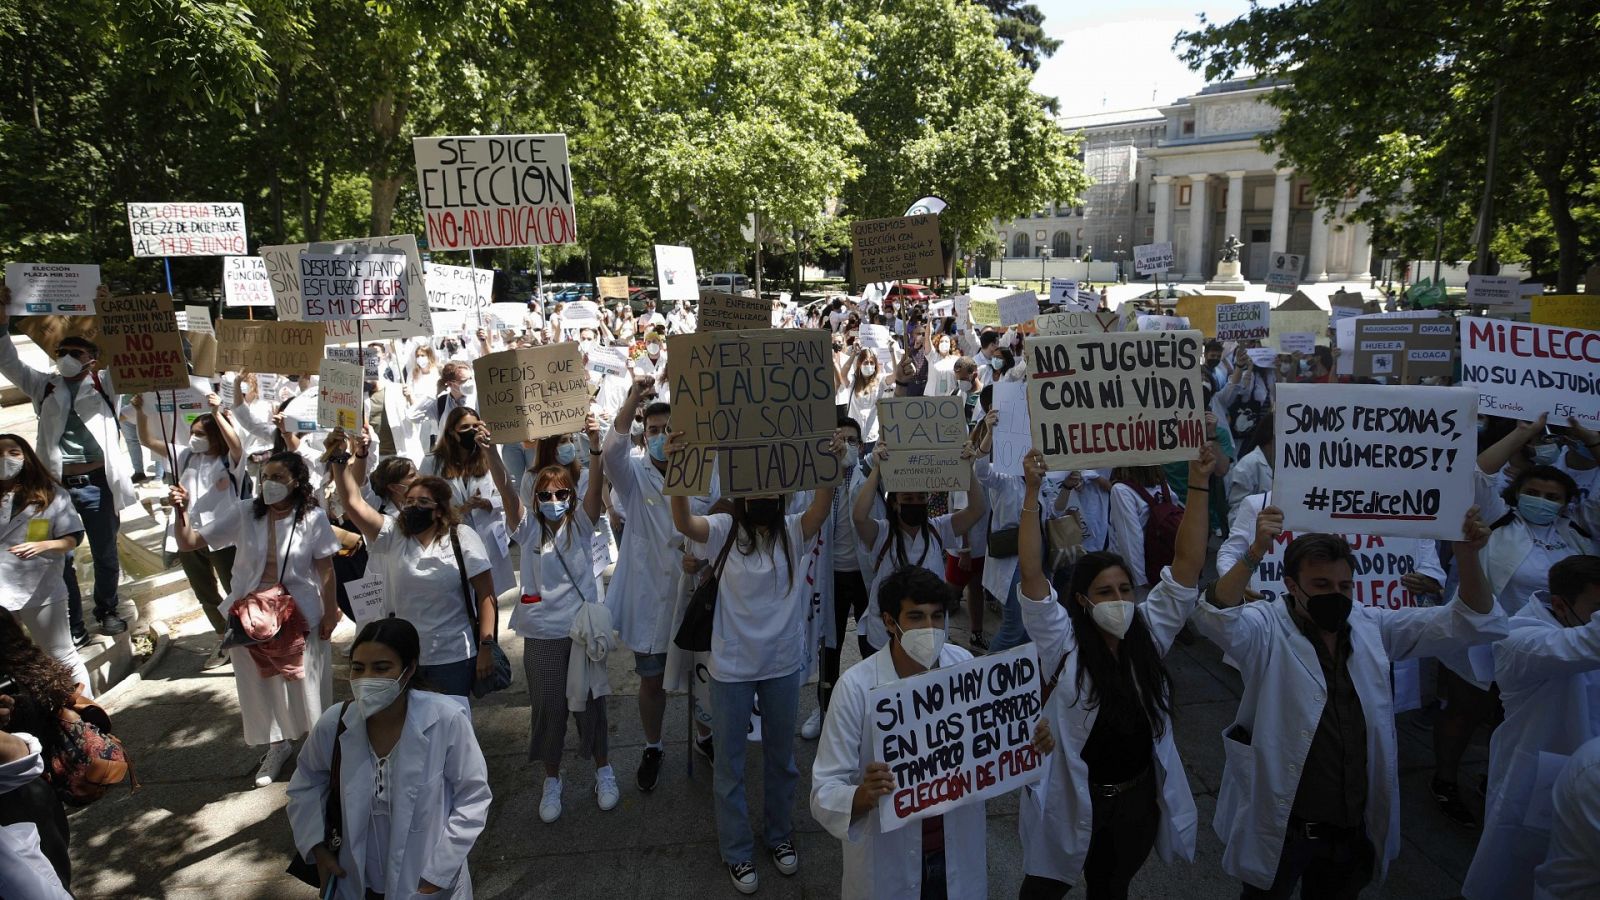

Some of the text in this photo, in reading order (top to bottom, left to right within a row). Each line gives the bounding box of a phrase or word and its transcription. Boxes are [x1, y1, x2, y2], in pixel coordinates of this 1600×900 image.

[438, 139, 547, 165] SE DICE
[131, 205, 242, 219] LA LOTERIA PASA
[133, 221, 240, 236] DEL 22 DE DICIEMBRE
[855, 216, 929, 235] QUEREMOS UNA
[136, 240, 155, 255] AL
[179, 237, 196, 254] DE
[200, 235, 245, 254] JUNIO
[898, 232, 913, 241] CON
[928, 239, 934, 247] Y
[232, 259, 265, 269] SI YA
[265, 251, 294, 272] SIN
[861, 258, 876, 266] QUE
[886, 256, 901, 264] LOS
[919, 249, 937, 258] NOS
[350, 259, 362, 277] DE
[364, 259, 404, 278] TANTO
[433, 266, 449, 277] SU
[880, 269, 919, 279] DECENCIA
[233, 282, 246, 292] PA
[272, 273, 300, 293] SIN
[303, 279, 405, 296] ESFUERZO ELEGIR
[101, 298, 159, 313] CAROLINA
[235, 293, 269, 302] TOCAS
[278, 296, 299, 315] NO
[428, 290, 449, 304] NOT
[704, 297, 717, 305] LA
[307, 299, 325, 316] ES
[351, 299, 408, 316] DERECHO
[123, 325, 135, 335] DE
[281, 328, 313, 346] OPACA
[1421, 325, 1451, 333] OPACA
[125, 334, 153, 351] NO
[1365, 342, 1393, 350] HUELE
[113, 350, 180, 367] ARRANCA
[254, 350, 261, 366] A
[267, 350, 309, 369] CLOACA
[328, 348, 354, 357] ERROR
[690, 340, 824, 369] AYER ERAN
[1034, 343, 1071, 374] NO
[1411, 351, 1447, 359] CLOACA
[120, 365, 173, 379] LA WEB
[547, 359, 574, 374] QUE
[1463, 363, 1489, 383] NO
[1491, 366, 1517, 385] SU
[487, 378, 587, 406] NOS APLAUDAN
[675, 366, 830, 406] APLAUSOS
[1039, 380, 1095, 411] CON
[515, 400, 563, 416] PERO NOS
[880, 400, 959, 420] TODO
[1478, 393, 1498, 409] FSE
[1499, 401, 1525, 412] unida
[1554, 403, 1577, 418] FSE
[526, 418, 535, 427] A
[539, 406, 585, 425] PATADAS
[696, 403, 813, 442] HOY SON
[1285, 403, 1348, 435] SOMOS
[881, 422, 956, 444] MAL
[1041, 423, 1069, 456] LA
[1158, 417, 1178, 450] ES
[1283, 442, 1311, 469] NO
[667, 438, 839, 493] BOFETADAS
[925, 476, 961, 489] CLOACA
[1302, 486, 1441, 516] #FSEdiceNO
[1387, 553, 1416, 576] POR
[352, 588, 383, 600] INCOMPET
[365, 597, 383, 607] SISTE
[1352, 580, 1418, 611] LEGIR
[912, 683, 944, 720] NO
[949, 668, 984, 705] HAY
[883, 730, 918, 762] EN
[925, 712, 964, 749] LAS
[892, 720, 1030, 789] TAMPOCO EN LA
[894, 744, 1042, 819] ELECCIÓN DE PLAZA
